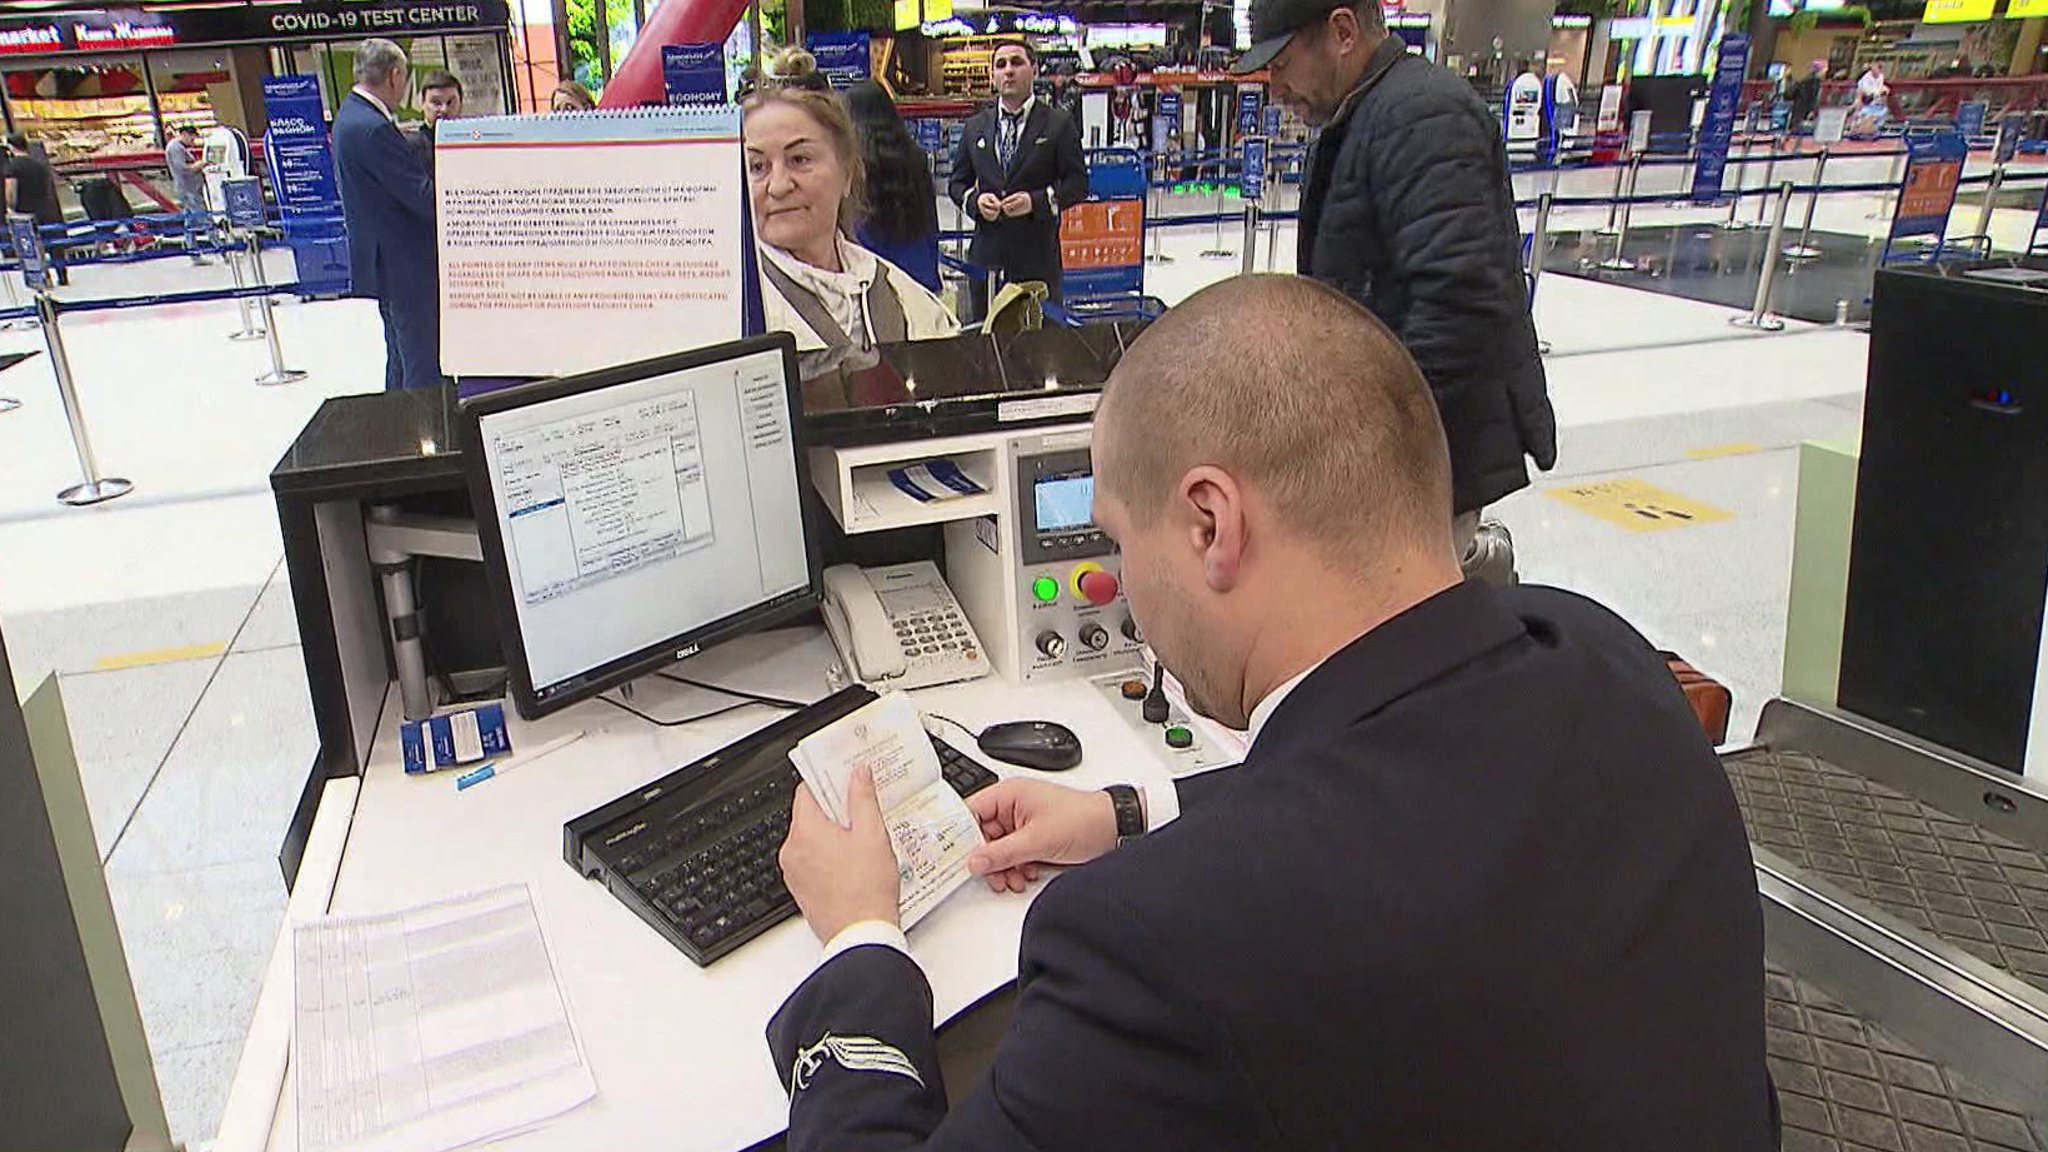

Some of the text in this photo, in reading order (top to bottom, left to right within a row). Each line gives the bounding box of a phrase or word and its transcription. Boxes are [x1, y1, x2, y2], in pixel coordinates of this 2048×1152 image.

[271, 5, 479, 31] COVID-19 TEST CENTER
[669, 89, 723, 104] ECONOMY
